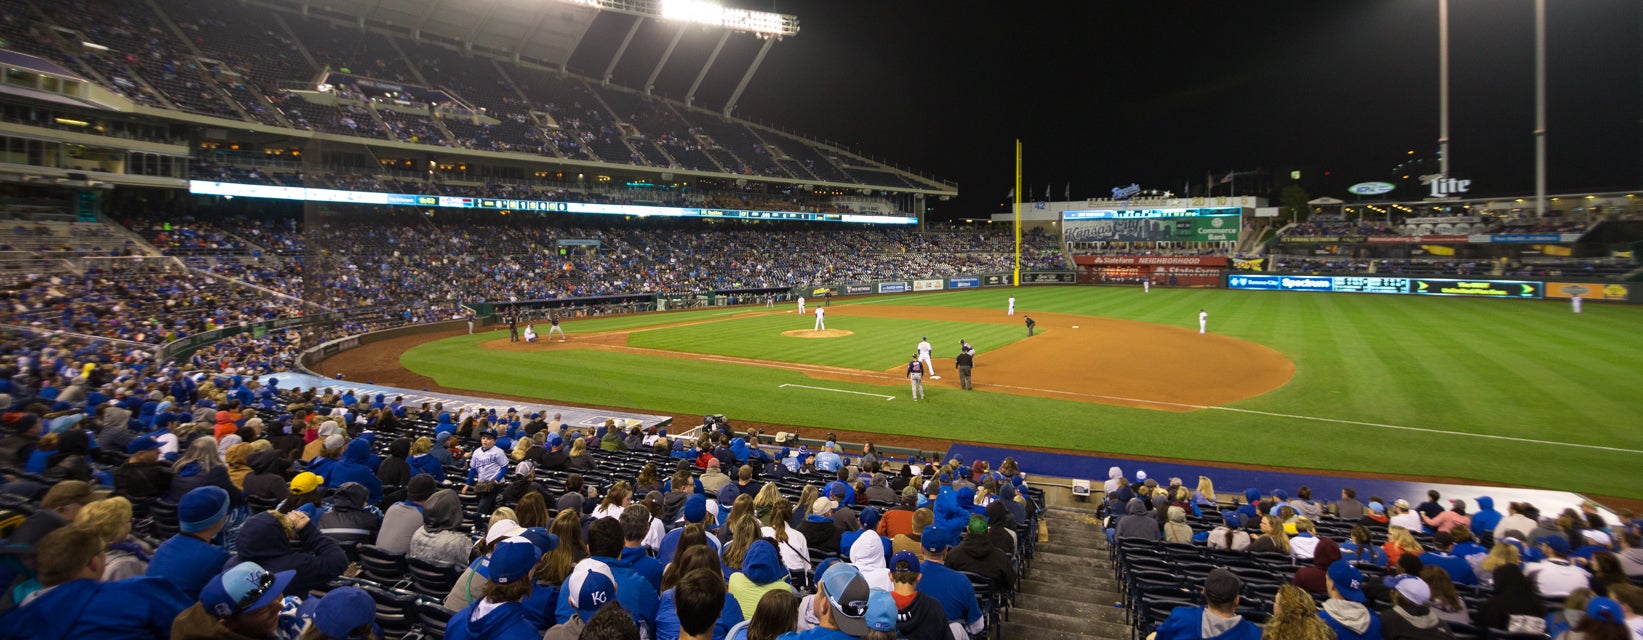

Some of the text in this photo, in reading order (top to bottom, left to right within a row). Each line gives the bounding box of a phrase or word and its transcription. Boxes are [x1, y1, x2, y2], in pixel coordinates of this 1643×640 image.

[1430, 176, 1472, 197] Lite
[1034, 201, 1046, 210] 42
[1192, 196, 1206, 206] 20
[1064, 219, 1140, 242] Kansas City
[1207, 233, 1227, 241] Bank
[1138, 256, 1200, 265] NEIGHBORHOOD
[1281, 278, 1331, 289] Spectrum
[822, 461, 829, 470] 5
[591, 590, 608, 606] KC
